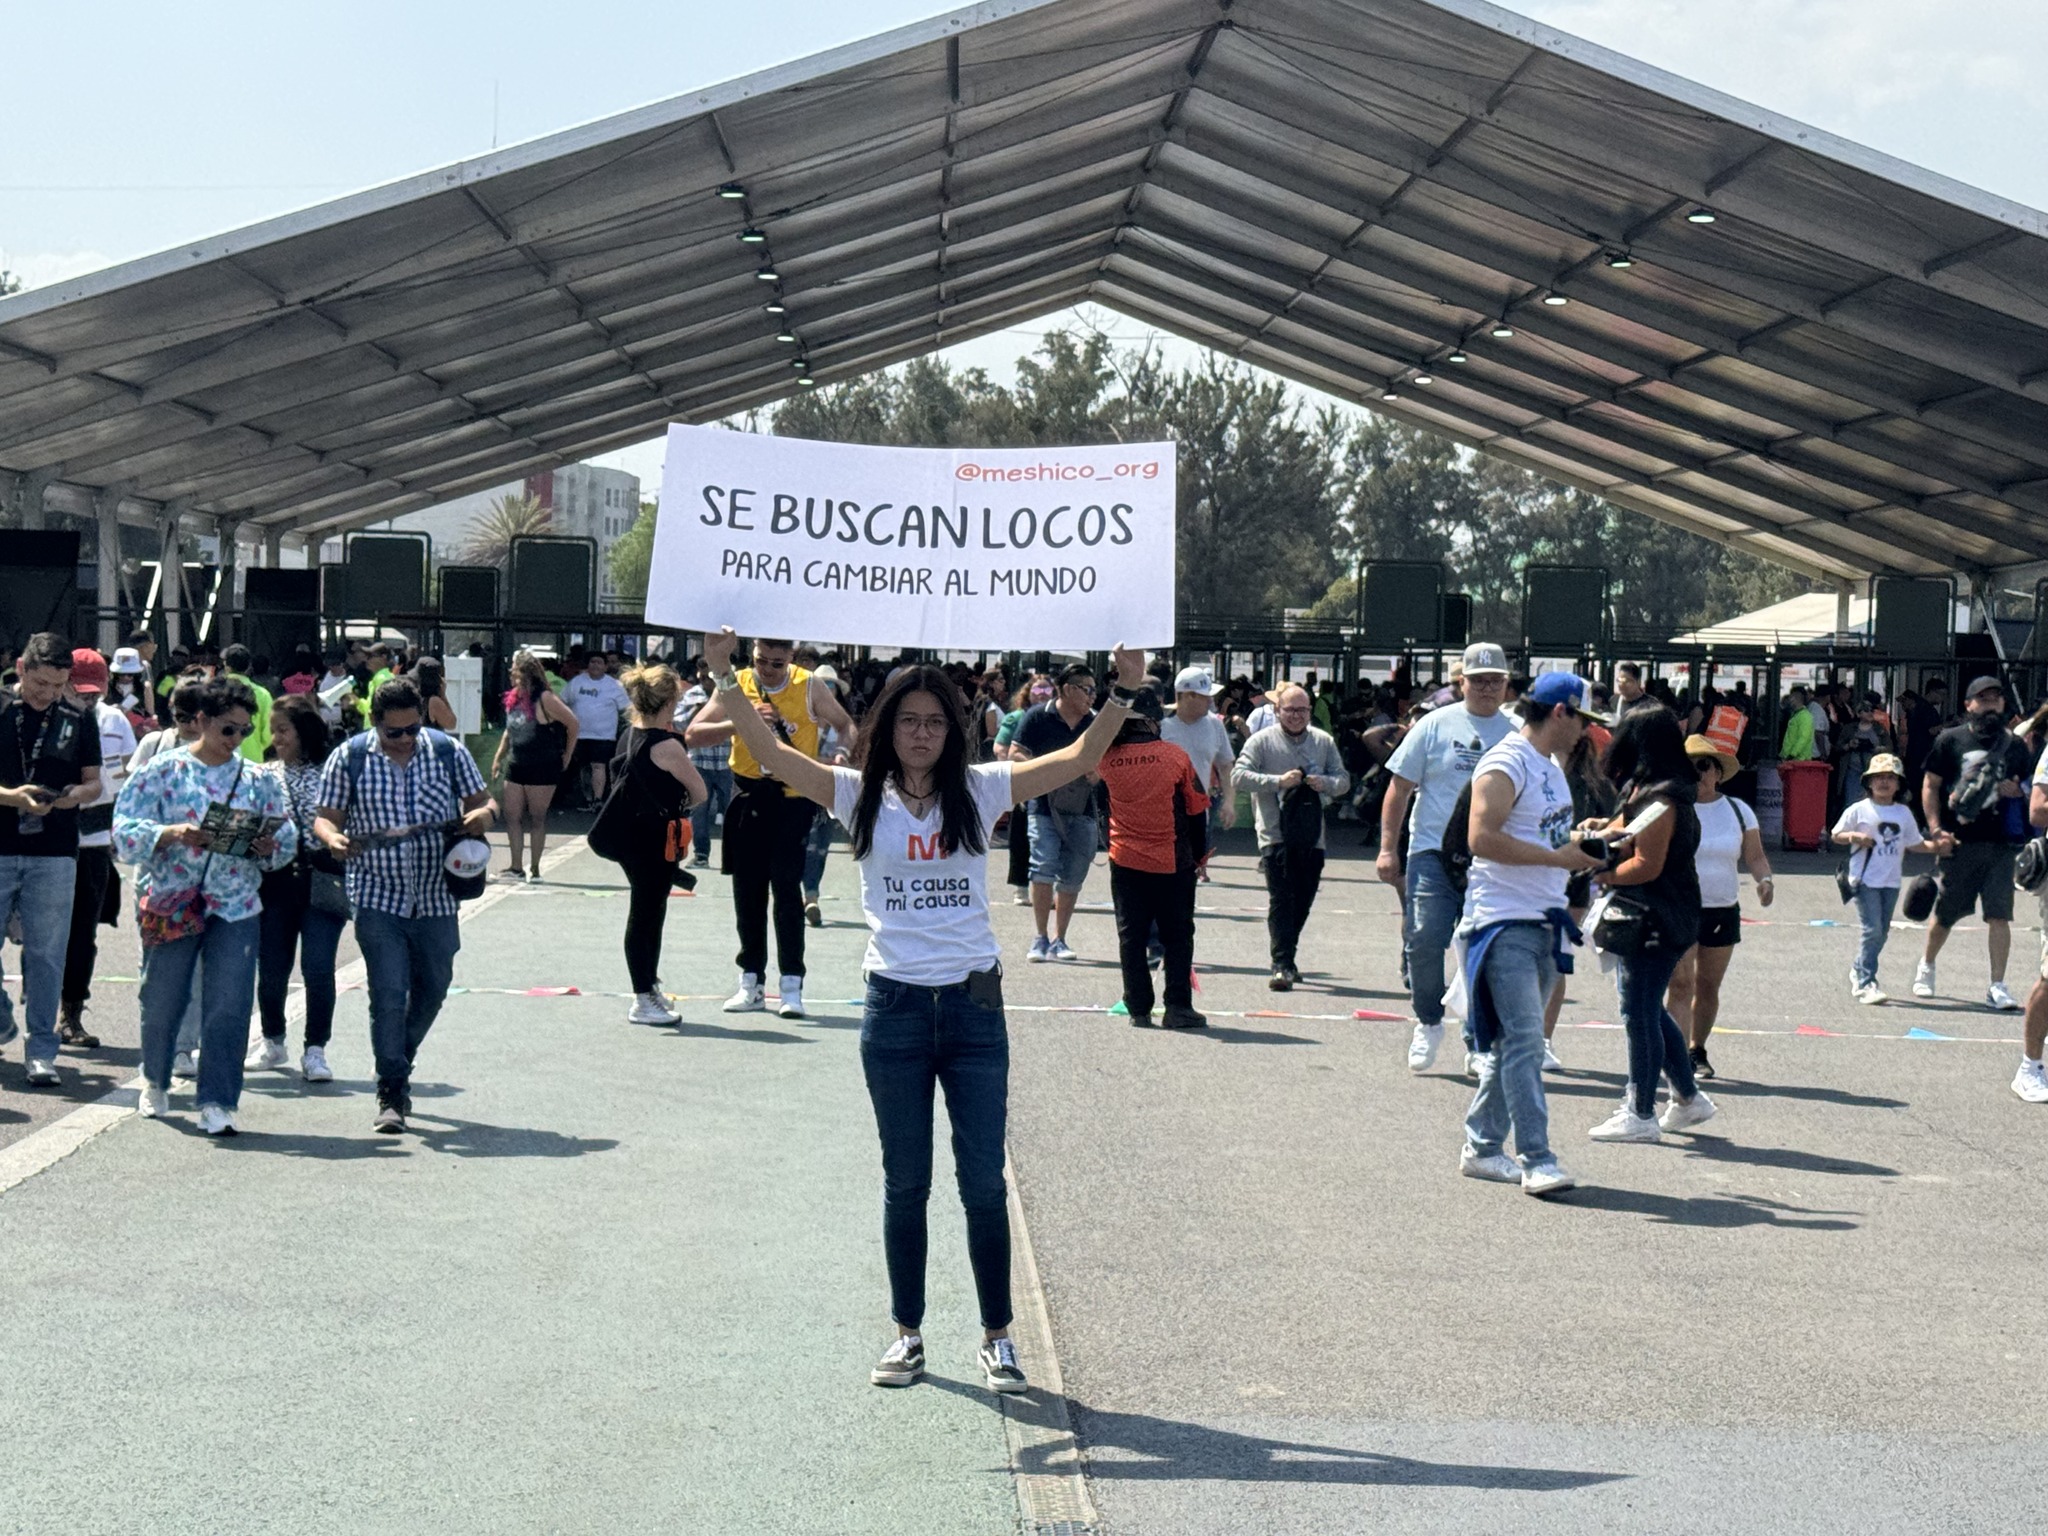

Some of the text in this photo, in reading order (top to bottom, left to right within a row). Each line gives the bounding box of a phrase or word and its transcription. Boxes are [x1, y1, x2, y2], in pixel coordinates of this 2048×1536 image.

[954, 461, 1160, 483] @meshico_org
[699, 485, 1134, 549] SE BUSCAN LOCOS
[721, 549, 1097, 596] PARA CAMBIAR AL MUNDO
[1110, 754, 1162, 767] CONTROL
[882, 876, 970, 893] Tu causa
[885, 894, 971, 912] mi causa
